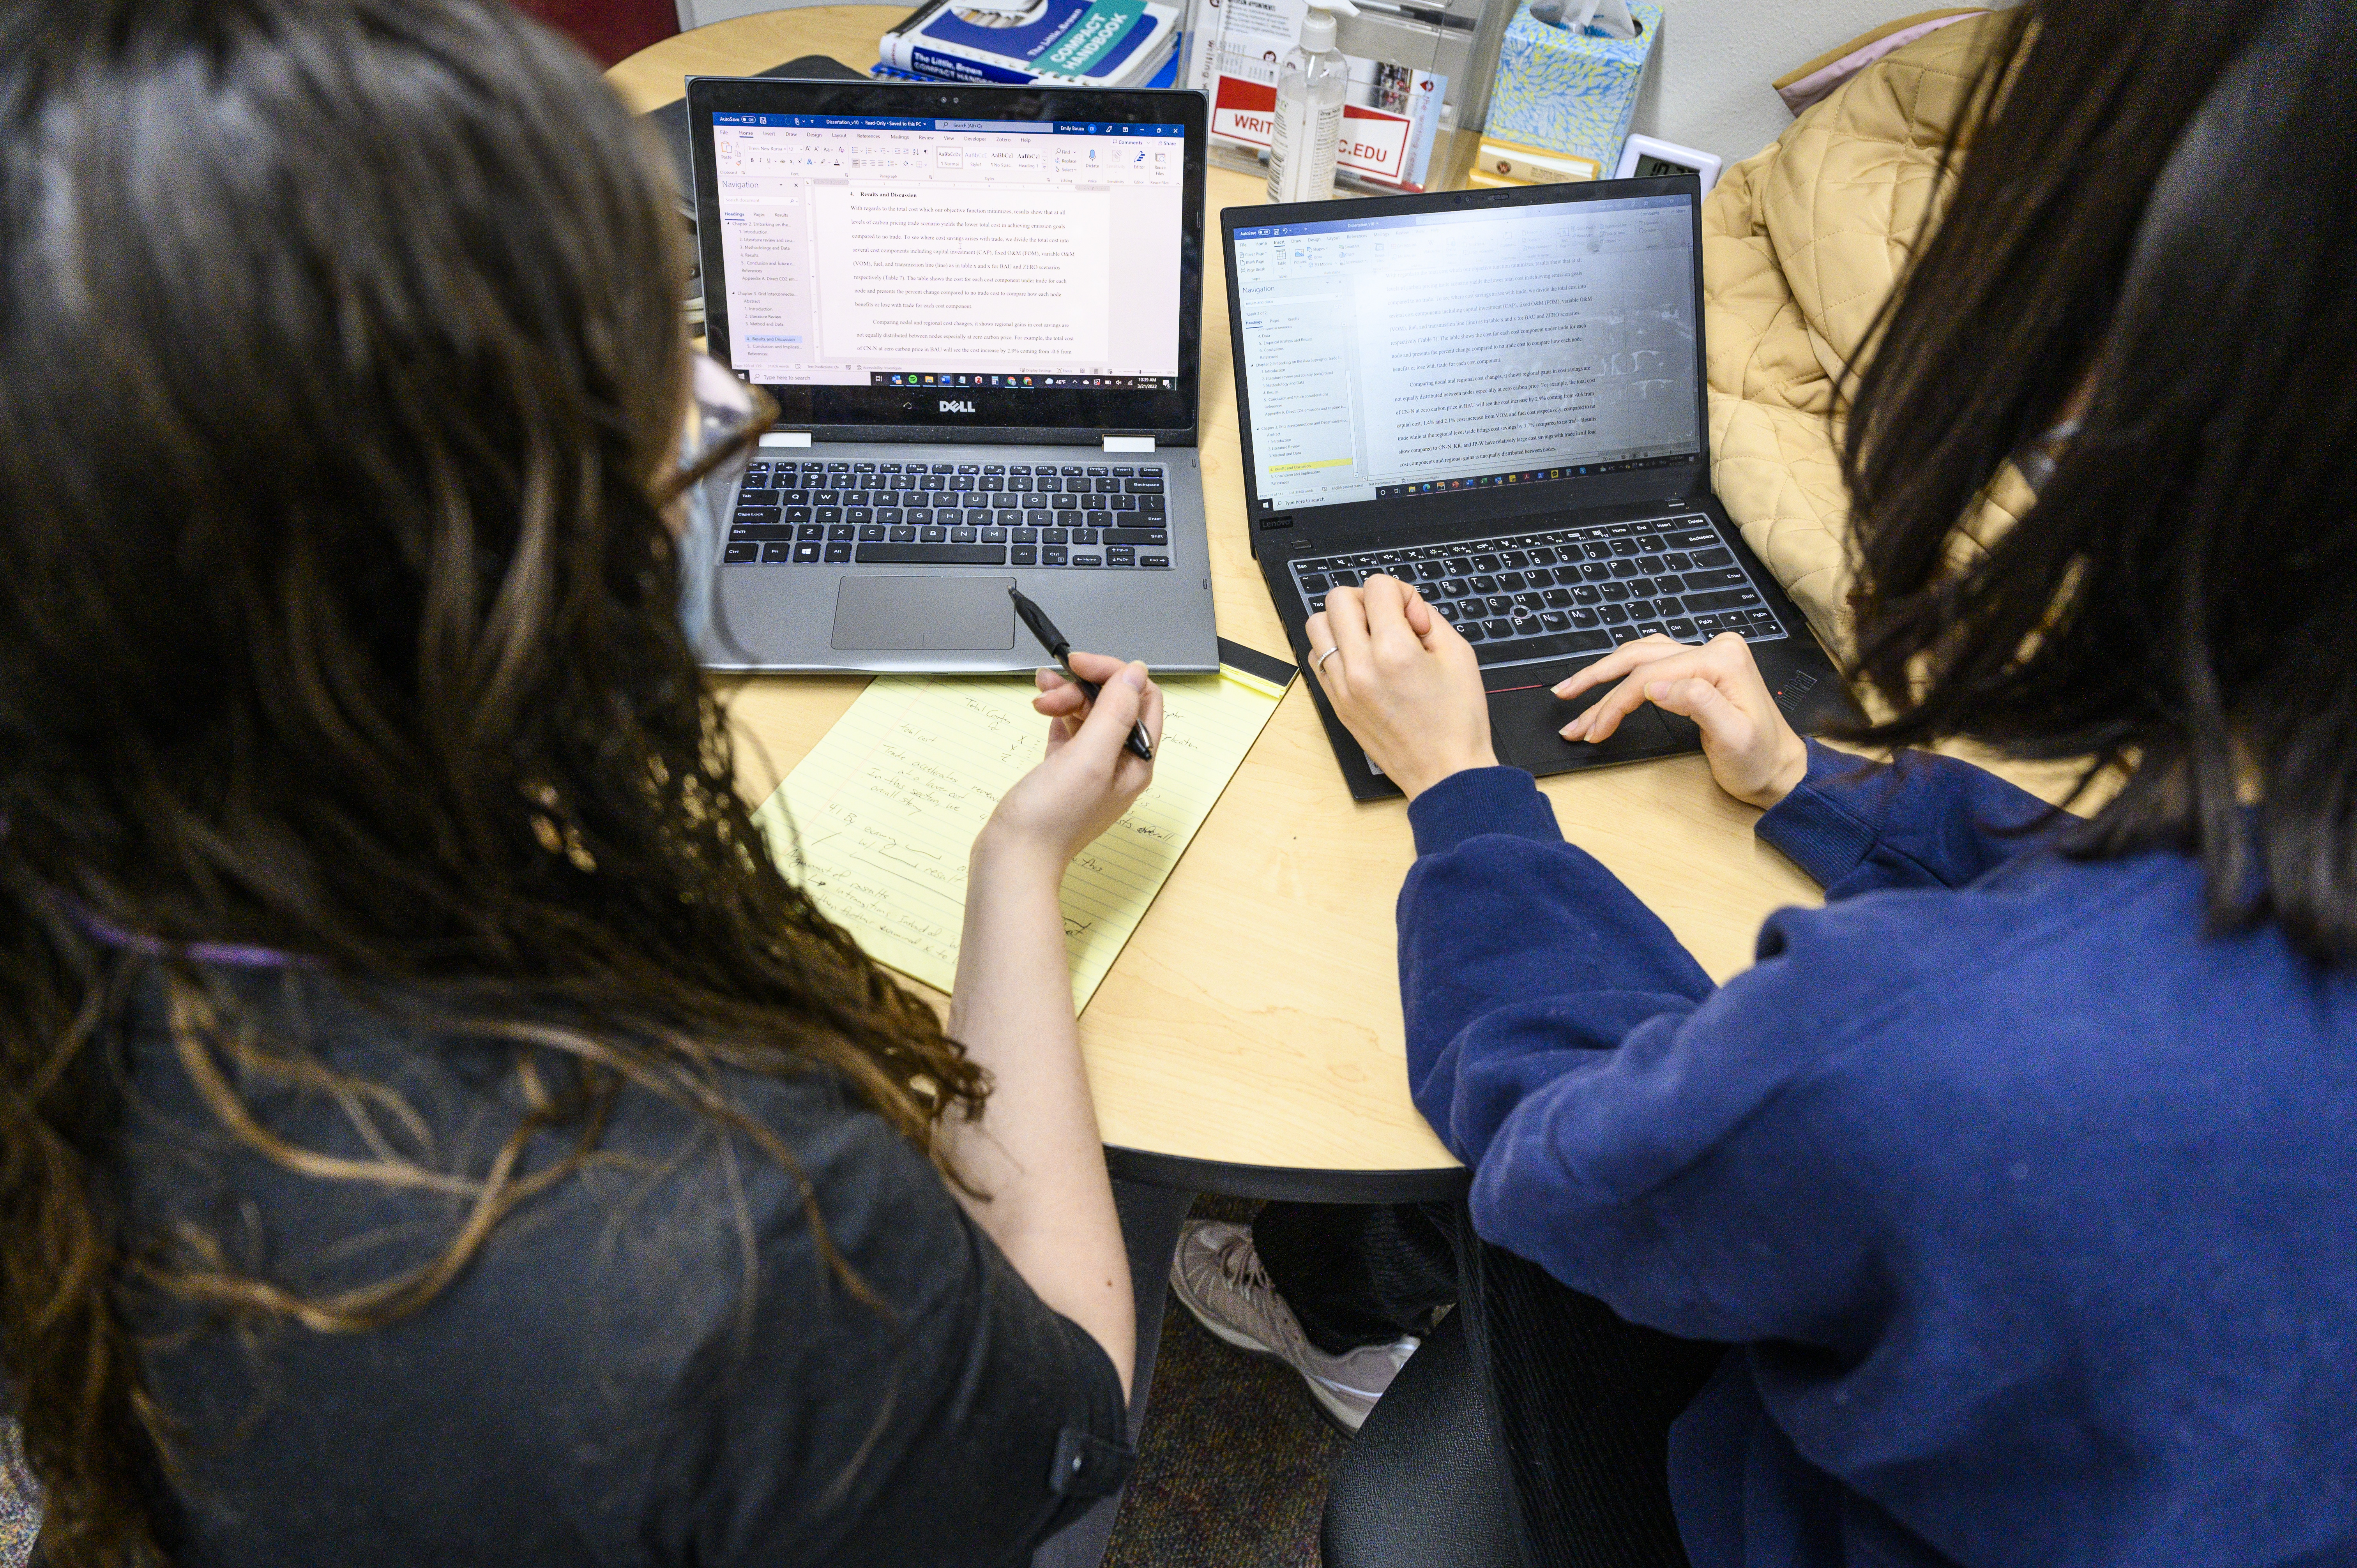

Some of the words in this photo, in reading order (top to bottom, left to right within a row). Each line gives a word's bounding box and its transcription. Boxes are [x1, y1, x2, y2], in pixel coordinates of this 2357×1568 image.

[1027, 45, 1044, 56] The
[1058, 9, 1083, 30] Brown
[1050, 12, 1106, 63] COMPACT
[1061, 12, 1128, 71] HANDBOOK
[913, 62, 955, 78] COMPACT
[914, 52, 930, 64] The
[955, 62, 983, 77] Brown
[1234, 113, 1274, 135] WRIT
[1338, 139, 1387, 163] C.EDU
[722, 180, 758, 189] Navigation
[939, 400, 975, 413] DELL
[1262, 520, 1290, 528] Lenovo
[1688, 534, 1715, 542] Backspace
[965, 697, 986, 713] Total
[986, 709, 1011, 724] Costs
[899, 724, 920, 737] total
[882, 744, 906, 761] Trade
[911, 760, 959, 783] accelerates
